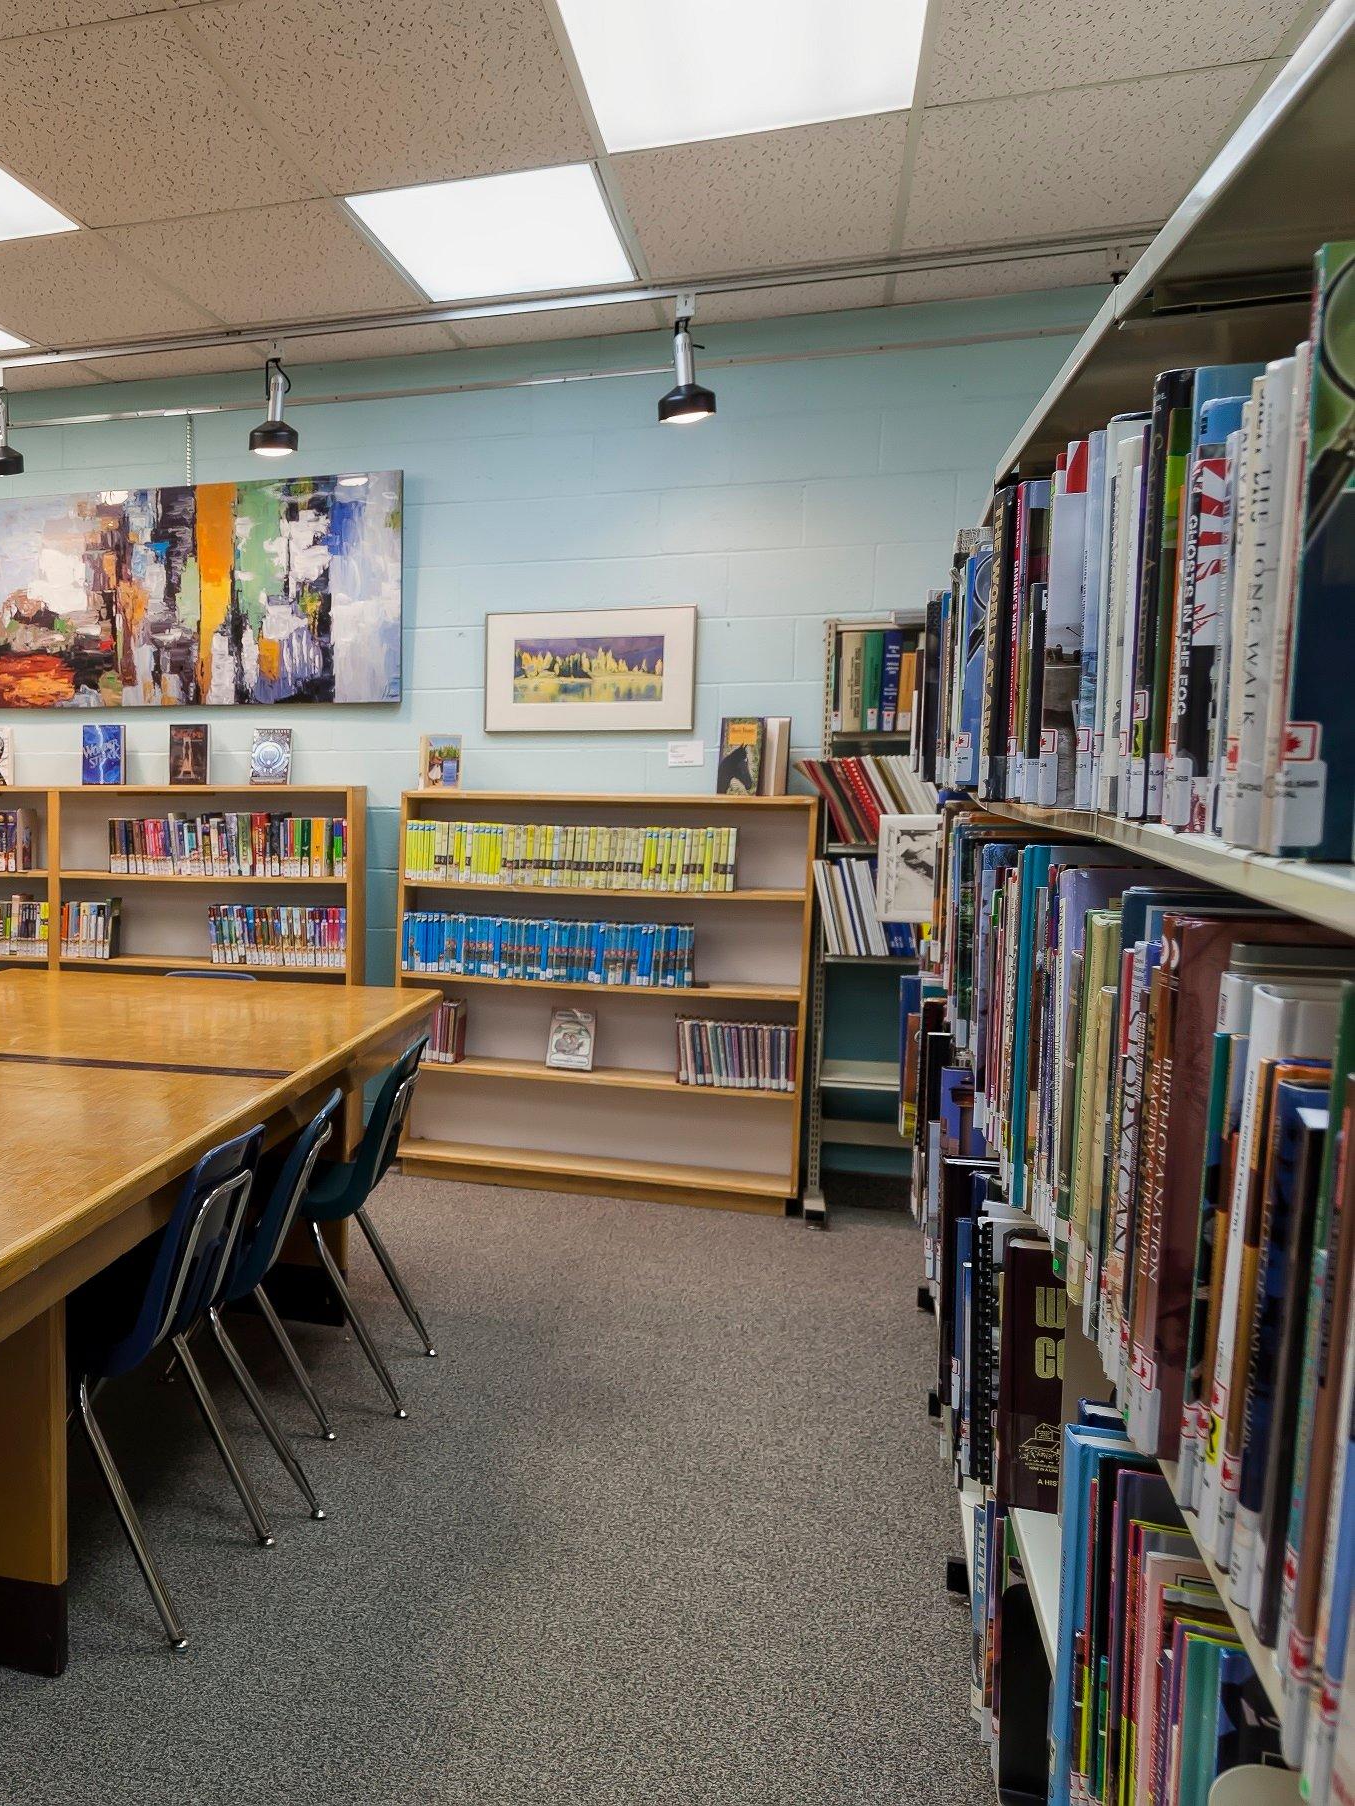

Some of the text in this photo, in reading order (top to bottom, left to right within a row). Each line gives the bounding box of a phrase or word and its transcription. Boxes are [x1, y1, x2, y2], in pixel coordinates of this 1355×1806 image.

[993, 502, 1005, 550] THE
[1183, 515, 1198, 598] GHOSTS
[987, 557, 1001, 651] WORLD
[1182, 604, 1195, 623] IN
[985, 657, 994, 688] AT
[1179, 631, 1192, 667] THE
[1136, 1055, 1144, 1074] FUR
[1113, 1011, 1142, 1256] STORY CAN
[1147, 1059, 1162, 1157] TRAGEDY
[1148, 1058, 1173, 1284] BIRTH OF A NATION
[1139, 1178, 1153, 1277] TRIUMPH
[1035, 1286, 1066, 1329] W
[1044, 1479, 1059, 1487] HIS
[976, 1523, 986, 1595] ALIVE
